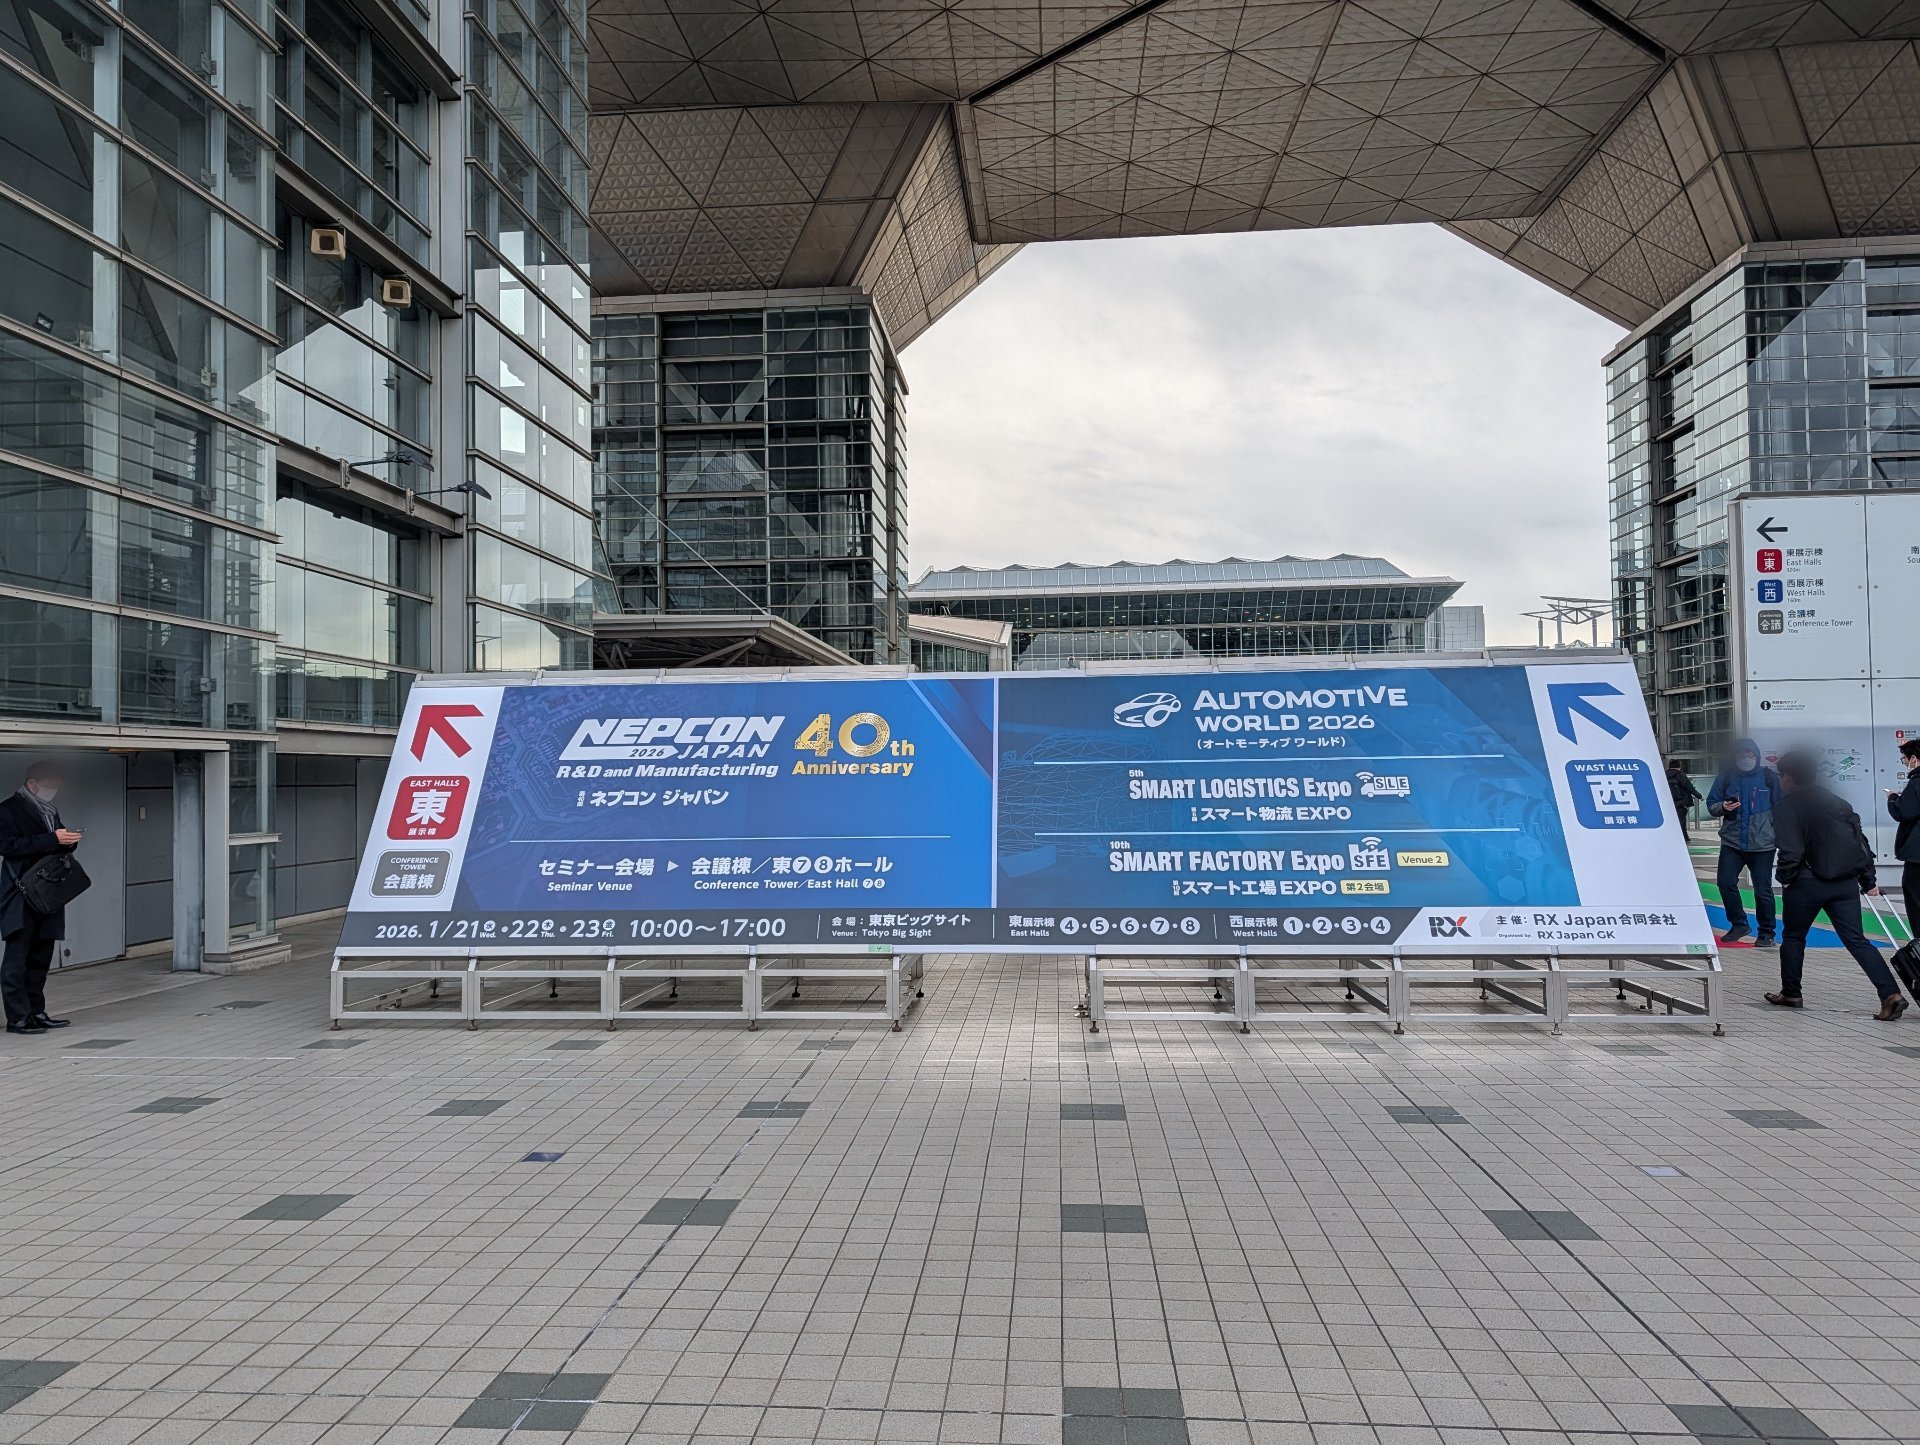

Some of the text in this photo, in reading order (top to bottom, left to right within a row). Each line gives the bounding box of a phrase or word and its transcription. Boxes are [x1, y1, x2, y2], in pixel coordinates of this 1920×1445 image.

[1786, 548, 1823, 557] 東展示棟
[1763, 558, 1775, 570] 東
[1803, 558, 1822, 566] Halls
[1786, 578, 1824, 588] 西展示棟
[1764, 588, 1776, 601] 西
[1807, 588, 1825, 596] Halls
[1788, 610, 1816, 618] 会議棟
[1760, 620, 1781, 631] 会議
[1831, 619, 1853, 627] Tower
[1193, 686, 1408, 710] AUTOMOTIVE
[1194, 714, 1375, 733] WORLD 2026
[559, 716, 785, 760] NEPCON
[629, 744, 770, 759] 2026 JAPAN
[556, 765, 602, 779] R&D
[603, 766, 634, 778] and
[635, 762, 779, 778] Manufacturing
[792, 760, 914, 777] Anniversary
[1129, 769, 1144, 778] 5th
[1574, 763, 1640, 772] WAST HALLS
[1129, 776, 1410, 801] SMART LOGISTICS Expo SLE
[1586, 775, 1640, 811] 西
[577, 790, 586, 807] 40
[590, 788, 729, 807] ネプコン ジャパン
[406, 789, 452, 825] 東
[1201, 806, 1293, 821] スマート物流
[1296, 806, 1351, 820] EXPO
[1109, 841, 1130, 849] 10th
[1109, 850, 1387, 875] SMART FACTORY Expo SFE
[1402, 856, 1442, 864] Venue 2
[539, 858, 655, 876] セミナー会場
[383, 873, 435, 890] 会議棟
[547, 882, 633, 891] Seminar Venue
[694, 879, 759, 890] Conference
[835, 879, 859, 888] Hall
[1346, 883, 1384, 891] 第2会場
[1182, 880, 1337, 896] スマート工場 EXPO
[868, 914, 971, 926] 東京ビッグサイト
[1008, 915, 1055, 927] 東展示棟
[1229, 915, 1278, 928] 西展示棟
[1533, 914, 1559, 926] RX
[374, 924, 423, 938] 2026.
[429, 920, 480, 938] 1/21
[1428, 916, 1472, 937] RX
[479, 931, 497, 939] Wed.
[861, 929, 889, 938] Tokyo
[892, 929, 907, 938] Big
[909, 929, 932, 938] Sight
[1010, 929, 1050, 937] East Halls
[1537, 931, 1555, 939] RX
[1556, 931, 1594, 941] Japan
[1596, 930, 1616, 939] GK
